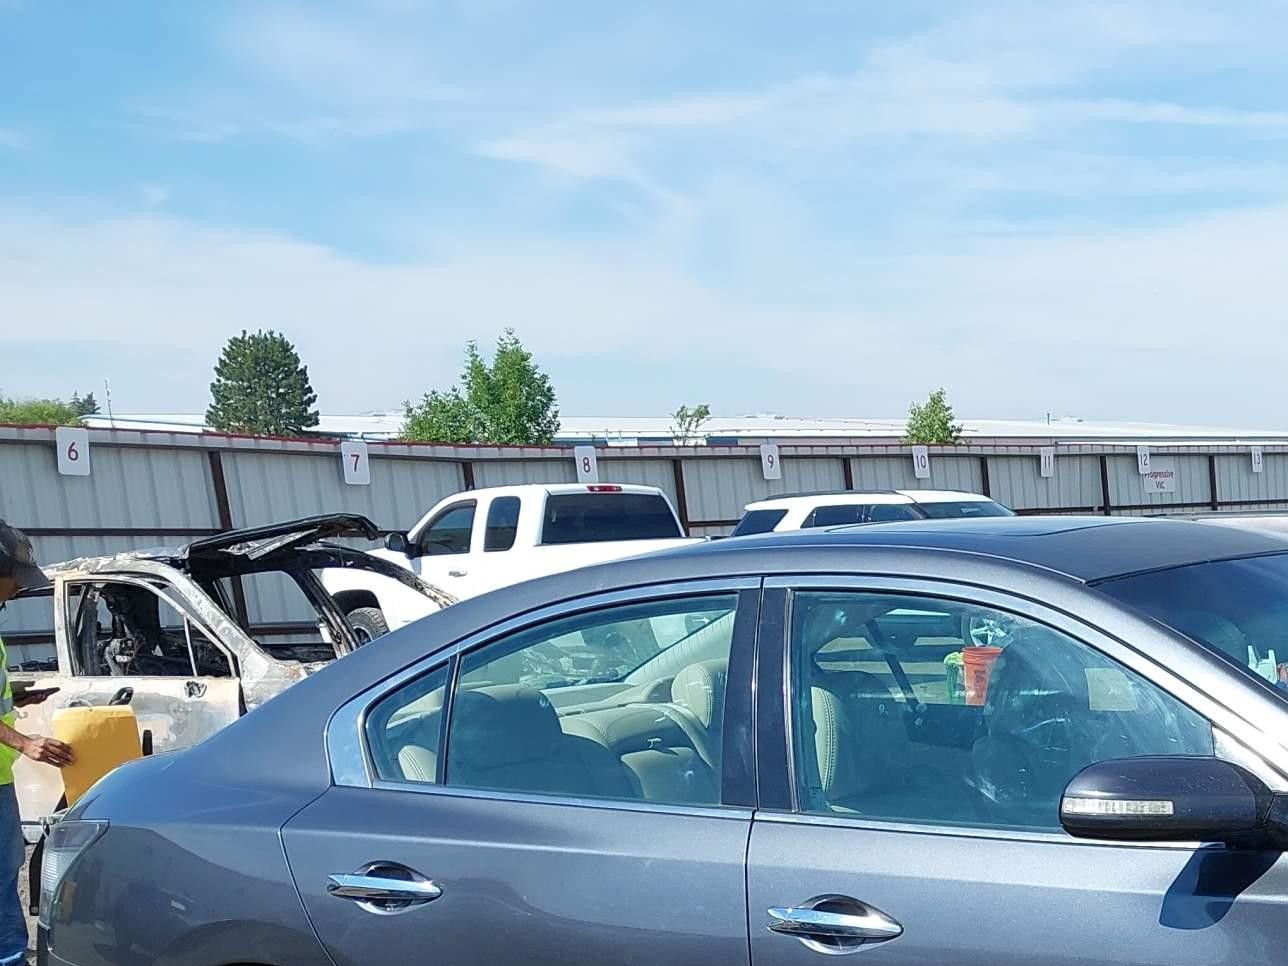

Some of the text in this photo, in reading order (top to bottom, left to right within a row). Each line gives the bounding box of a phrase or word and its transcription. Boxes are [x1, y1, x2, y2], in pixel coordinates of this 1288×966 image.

[67, 441, 79, 461] 6
[350, 454, 360, 472] 7
[582, 456, 591, 473] 8
[767, 454, 774, 469] 9
[916, 454, 927, 469] 10
[1044, 458, 1051, 469] 11
[1140, 453, 1149, 466] 12
[1253, 454, 1261, 465] 13
[1155, 480, 1166, 490] VIC
